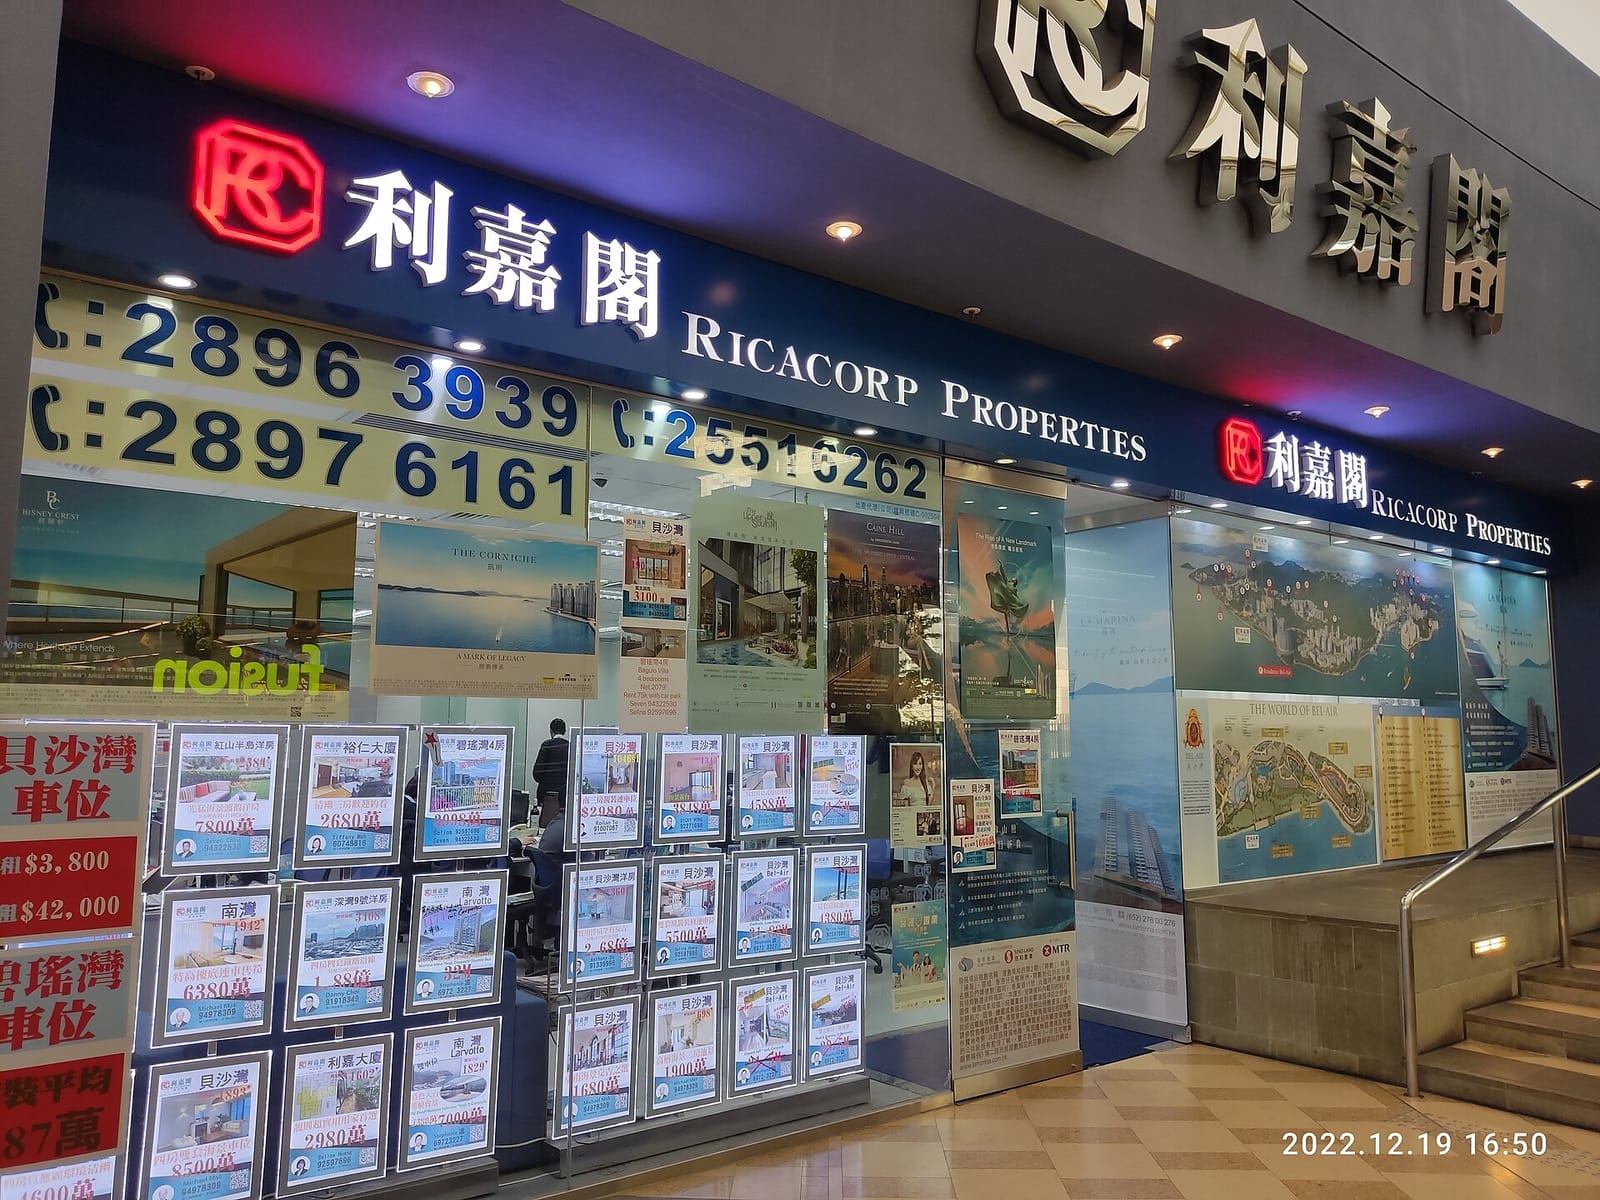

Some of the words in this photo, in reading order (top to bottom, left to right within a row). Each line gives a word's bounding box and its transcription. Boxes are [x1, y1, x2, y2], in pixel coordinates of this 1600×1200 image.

[1169, 18, 1512, 335] 利嘉閣
[342, 169, 661, 339] 利嘉閣
[681, 311, 918, 407] RICACORP
[941, 379, 1146, 462] PROPERTIES
[391, 355, 579, 437] 3939
[1263, 430, 1369, 508] 利嘉閣
[394, 441, 574, 516] 6161
[652, 521, 684, 537] 貝沙灣
[866, 522, 888, 535] CAINE
[888, 525, 905, 537] HILL
[1015, 538, 1037, 547] Landmark
[451, 547, 475, 559] THE
[479, 550, 538, 564] CORNICHE
[633, 591, 658, 603] 3100
[36, 641, 78, 653] Heritage
[79, 643, 115, 653] Extends
[462, 653, 485, 661] MARK
[486, 654, 497, 662] OF
[497, 655, 527, 663] LEGACY
[637, 667, 656, 675] Baguio
[629, 700, 647, 708] Seven
[647, 700, 677, 708] 94322530
[669, 693, 682, 702] park
[629, 708, 647, 716] Selina
[1250, 703, 1266, 716] THE
[1267, 703, 1298, 717] WORLD
[1299, 704, 1311, 717] OF
[1311, 704, 1339, 717] BEL-AIR
[343, 740, 397, 755] 裕仁大廈
[605, 741, 637, 753] 貝沙灣
[690, 739, 719, 751] 貝沙灣
[762, 741, 790, 752] 貝沙灣
[0, 735, 138, 776] 貝沙灣
[970, 783, 991, 794] 貝沙灣
[11, 779, 112, 823] 車位
[194, 817, 254, 835] 7800萬
[320, 810, 381, 831] 2680萬
[833, 855, 858, 867] 貝沙灣
[595, 871, 636, 884] 貝沙灣洋房
[683, 866, 714, 879] 貝沙灣
[766, 869, 789, 877] Bel-Air
[461, 885, 490, 898] 南灣
[334, 894, 388, 907] 深灣9號洋房
[221, 901, 257, 920] 南灣
[665, 926, 708, 944] 5500萬
[1052, 943, 1071, 955] MTR
[183, 977, 251, 1000] 6380萬
[325, 991, 345, 1000] Danny
[681, 995, 712, 1011] 貝沙灣
[0, 999, 97, 1051] 車位
[593, 1009, 628, 1027] 貝沙灣
[453, 1034, 482, 1050] 南灣
[450, 1046, 485, 1058] Larvotto
[327, 1050, 382, 1070] 利嘉大廈
[664, 1057, 708, 1078] 1900萬
[199, 1068, 249, 1090] 貝沙灣
[304, 1124, 367, 1149] 2980萬
[172, 1151, 236, 1177] 8500萬
